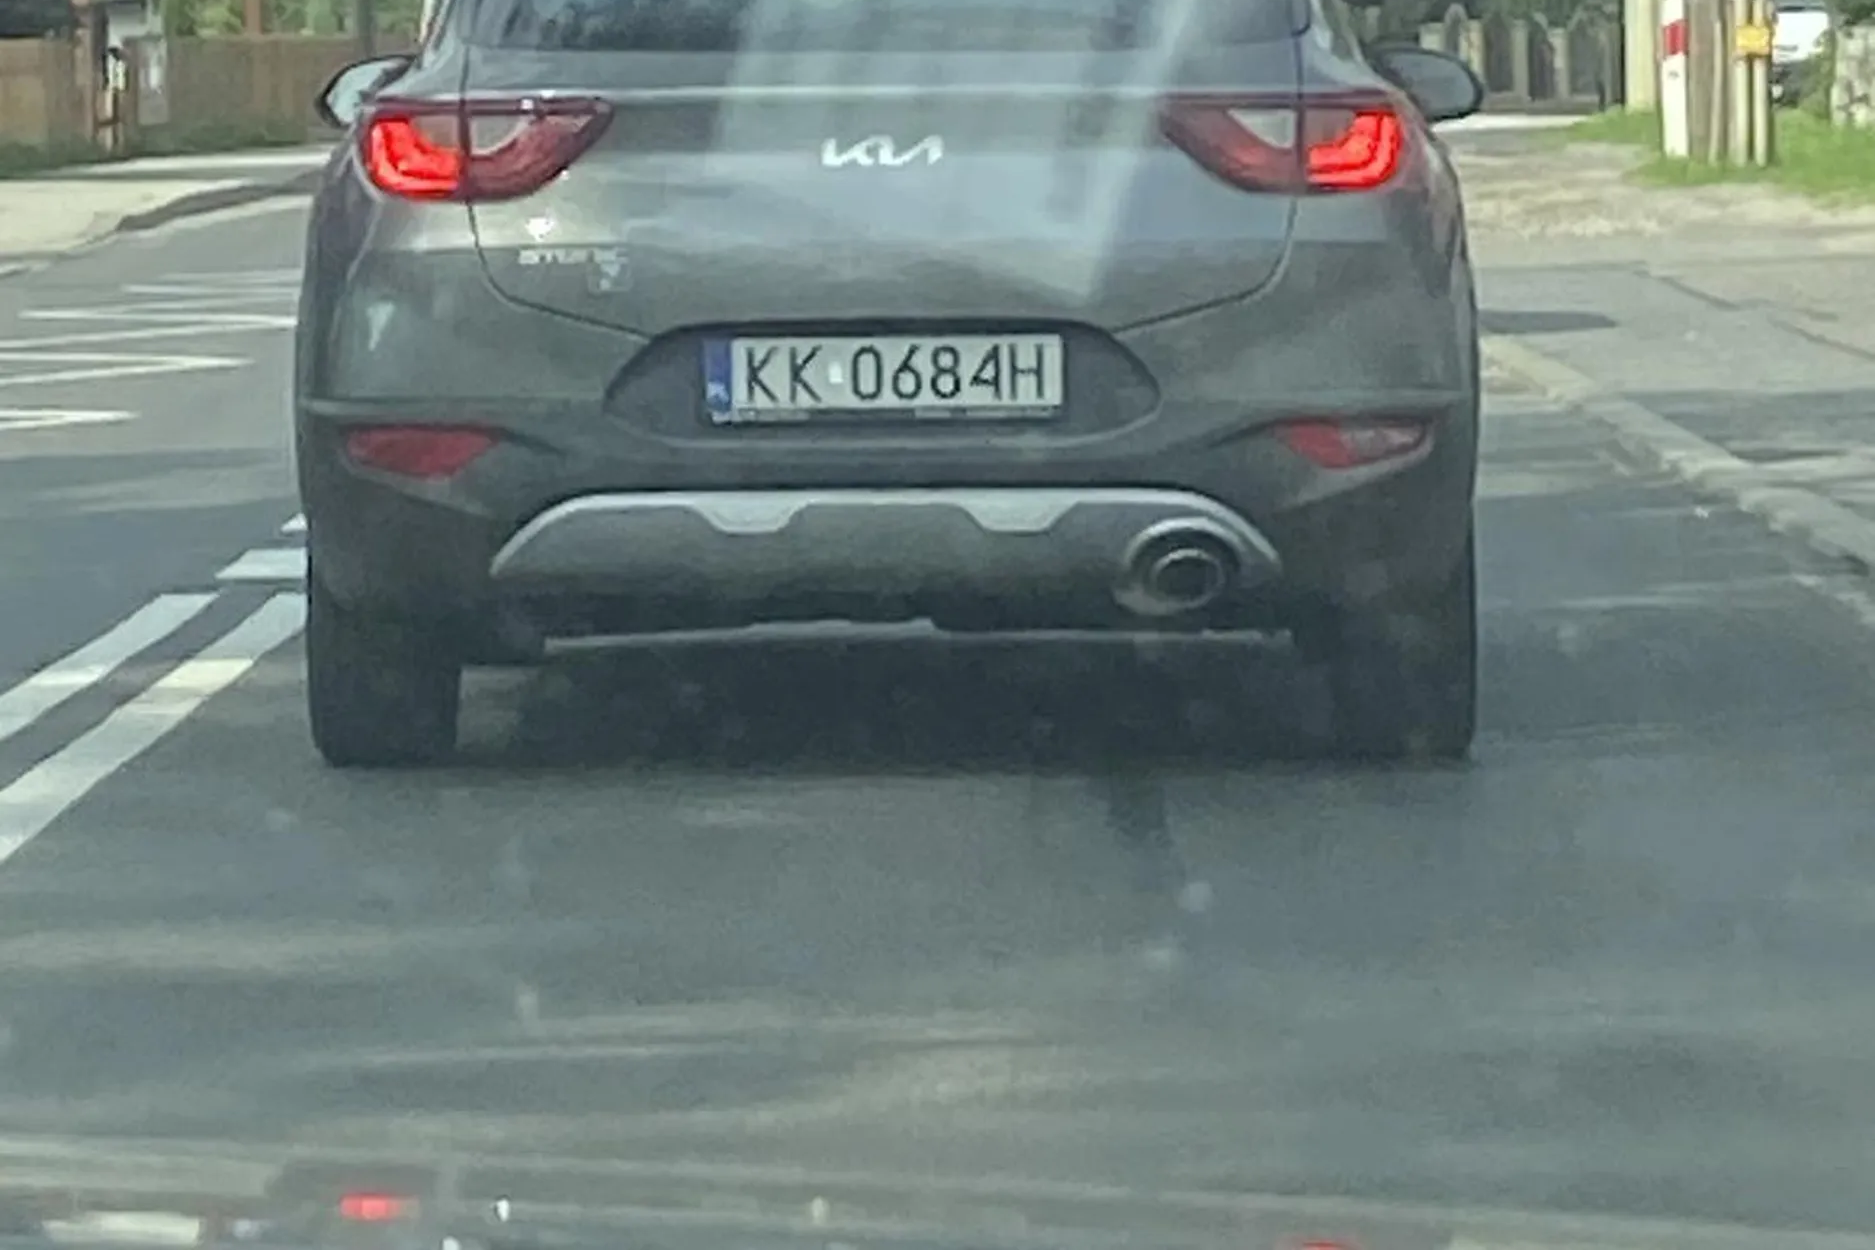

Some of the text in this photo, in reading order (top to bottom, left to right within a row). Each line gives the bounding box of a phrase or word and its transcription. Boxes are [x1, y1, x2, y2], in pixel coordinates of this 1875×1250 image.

[820, 134, 943, 166] KIA
[745, 343, 1045, 402] KK 0684H
